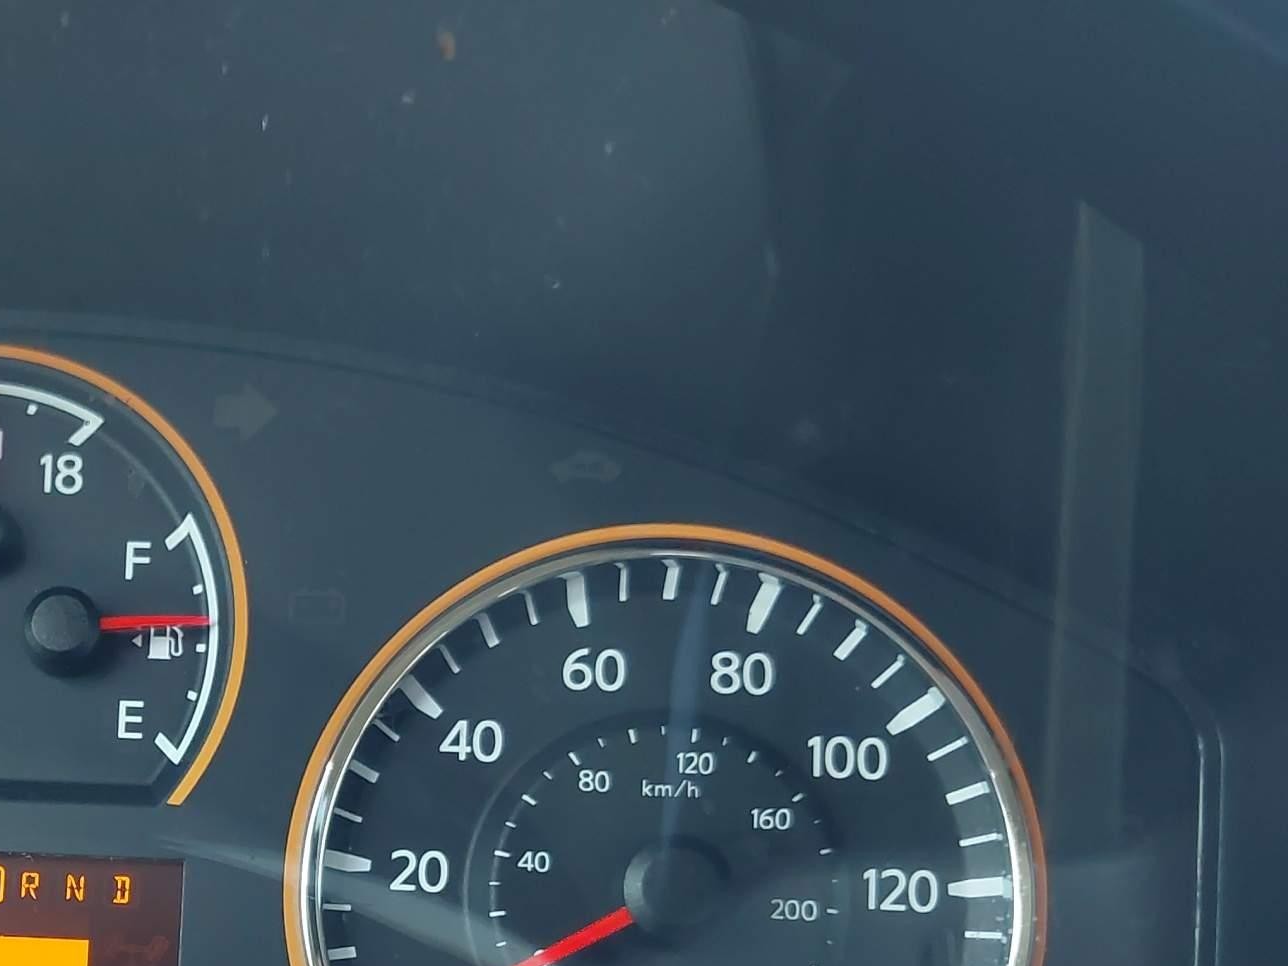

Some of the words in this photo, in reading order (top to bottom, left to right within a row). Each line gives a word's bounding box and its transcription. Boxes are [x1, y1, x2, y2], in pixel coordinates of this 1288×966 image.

[39, 453, 84, 495] 18
[124, 540, 152, 581] F
[562, 648, 627, 693] 60
[710, 651, 775, 697] 80
[117, 699, 145, 740] E
[439, 719, 503, 763] 40
[806, 735, 889, 781] 100
[578, 769, 611, 794] 80
[675, 751, 714, 776] 120
[641, 777, 701, 801] km/h
[750, 807, 792, 831] 160
[389, 849, 449, 894] 20
[517, 850, 550, 874] 40
[20, 871, 40, 900] R
[66, 873, 85, 902] N
[112, 874, 131, 904] D
[862, 867, 938, 914] 120
[770, 898, 818, 923] 200
